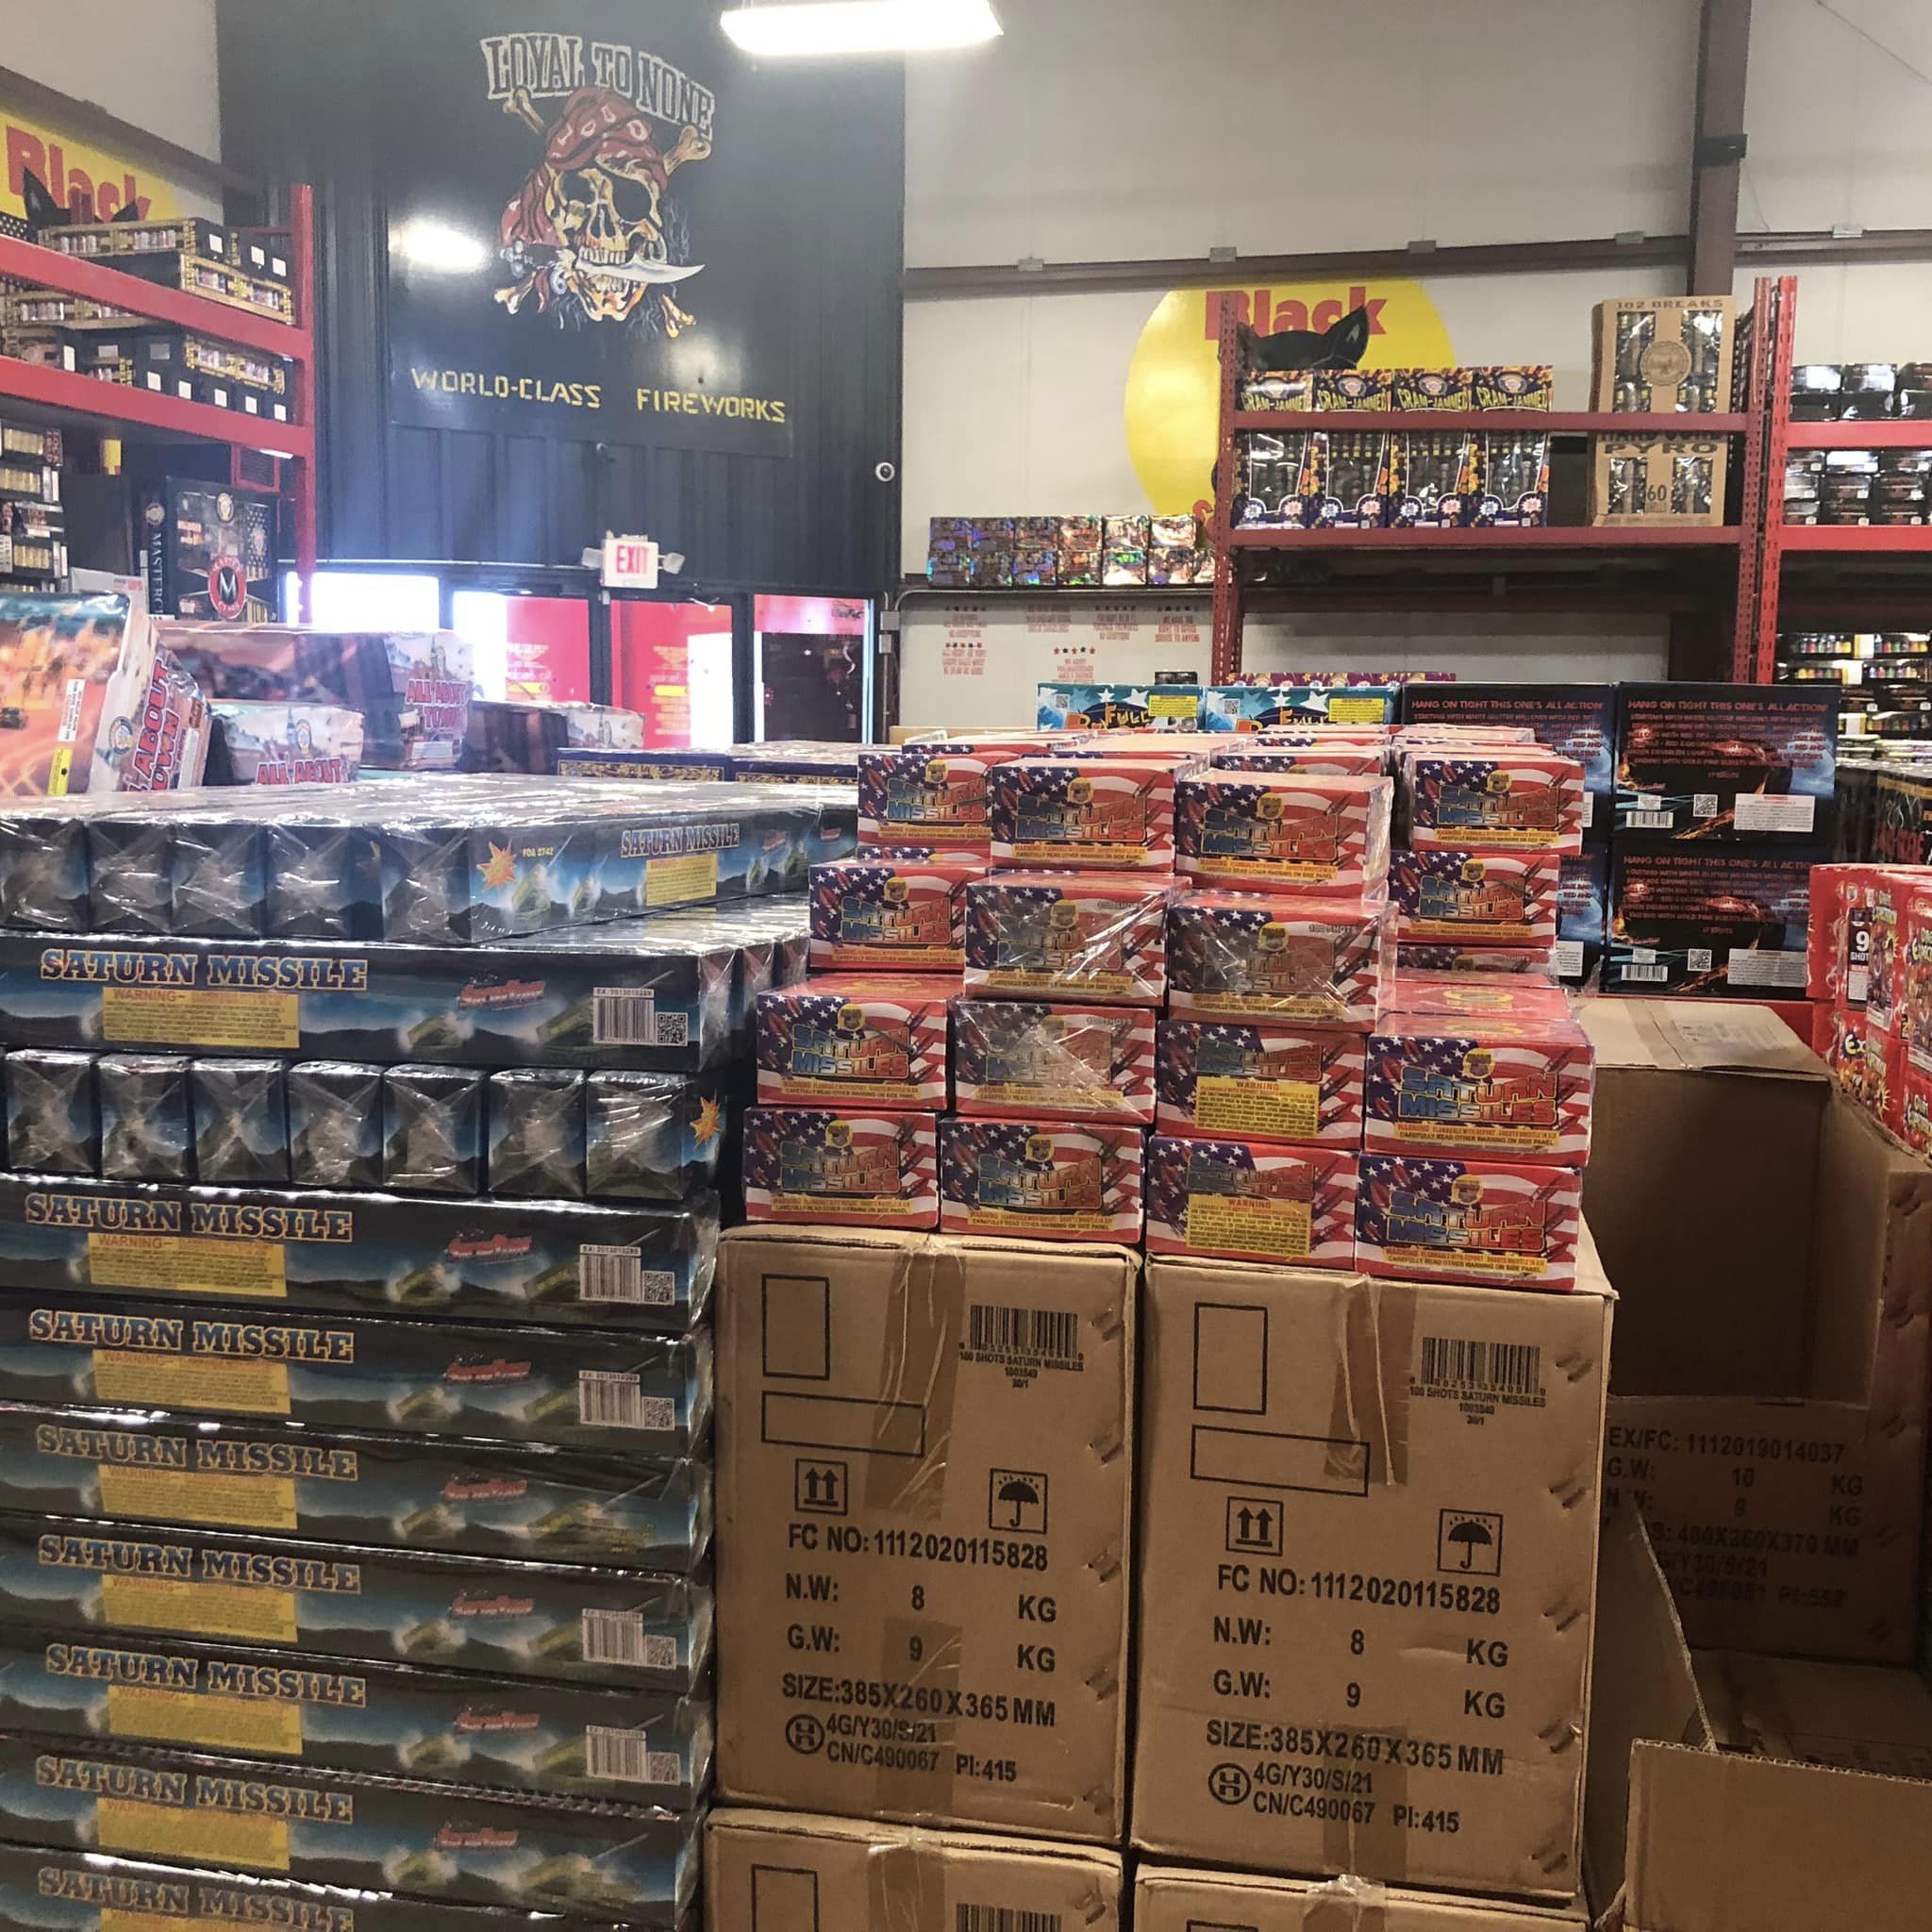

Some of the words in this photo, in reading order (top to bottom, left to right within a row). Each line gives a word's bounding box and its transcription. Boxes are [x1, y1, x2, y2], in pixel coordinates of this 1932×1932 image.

[481, 32, 585, 100] LOYAL
[591, 42, 633, 98] TO
[636, 51, 715, 142] NONE
[1652, 299, 1724, 309] BREAKS
[410, 367, 602, 408] WORLD-CLASS
[636, 388, 787, 424] FIREWORKS
[1604, 442, 1719, 455] PYRO
[1646, 484, 1668, 502] 60
[616, 543, 649, 575] EXIT
[406, 679, 432, 705] ALL
[1411, 700, 1440, 709] HANG
[1441, 700, 1457, 709] ON
[1459, 700, 1489, 709] TIGHT
[1491, 700, 1511, 709] THIS
[1545, 701, 1562, 710] ALL
[1627, 700, 1657, 709] HANG
[1659, 700, 1675, 709] ON
[1678, 701, 1708, 710] TIGHT
[1710, 701, 1732, 711] THIS
[1767, 703, 1786, 712] ALL
[133, 658, 171, 781] ABOUT
[151, 708, 180, 791] OWN
[256, 760, 291, 785] ALL
[620, 828, 681, 858] SATURN
[685, 823, 741, 854] MISSILE
[1856, 930, 1870, 952] 9
[40, 947, 198, 986] SATURN
[206, 953, 370, 991] MISSILE
[791, 1024, 910, 1058] SATURN
[791, 1051, 910, 1080] MISSILES
[1237, 1080, 1279, 1091] WARNING
[1397, 1066, 1558, 1104] SATURN
[1397, 1091, 1558, 1125] MISSILES
[1400, 1131, 1435, 1141] CAREFULLY
[1436, 1133, 1453, 1141] READ
[1454, 1134, 1476, 1142] OTHER
[1477, 1135, 1507, 1144] WARNING
[1507, 1137, 1517, 1145] ON
[1533, 1139, 1555, 1147] PANEL
[978, 1153, 1102, 1190] SATURN
[978, 1179, 1102, 1209] MISSILES
[1228, 1199, 1272, 1208] WARNING
[1386, 1190, 1547, 1227] SATURN
[25, 1192, 182, 1232] SATURN
[190, 1201, 353, 1243] MISSILE
[1386, 1216, 1547, 1253] MISSILES
[29, 1308, 184, 1352] SATURN
[192, 1320, 355, 1364] MISSILE
[959, 1351, 974, 1361] 100
[975, 1352, 1005, 1364] SHOTS
[1007, 1356, 1041, 1368] SATURN
[1043, 1358, 1084, 1372] MISSILES
[1409, 1385, 1424, 1397] 100
[1426, 1387, 1459, 1400] SHOTS
[1461, 1391, 1499, 1404] SATURN
[1502, 1393, 1546, 1408] MISSILES
[36, 1424, 187, 1468] SATURN
[196, 1440, 358, 1481] MISSILE
[1608, 1425, 1679, 1452] EX/FC:
[1687, 1432, 1845, 1463] 1112019014037
[1606, 1457, 1656, 1480] G.W:
[1731, 1467, 1755, 1488] 10
[1830, 1474, 1863, 1497] KG
[1828, 1505, 1862, 1527] KG
[38, 1533, 192, 1578] SATURN
[202, 1548, 361, 1594] MISSILE
[788, 1523, 818, 1551] FC
[827, 1526, 869, 1554] NO:
[874, 1530, 1048, 1572] 1112020115828
[785, 1573, 839, 1603] N.W:
[911, 1584, 925, 1611] 8
[1018, 1593, 1058, 1624] KG
[1218, 1564, 1250, 1592] FC
[1259, 1567, 1306, 1596] NO:
[1311, 1571, 1500, 1616] 1112020115828
[787, 1623, 841, 1653] G.W:
[908, 1635, 923, 1662] 9
[1017, 1644, 1056, 1673] KG
[1214, 1616, 1272, 1647] N.W:
[1350, 1628, 1365, 1656] 8
[1466, 1638, 1509, 1668] KG
[45, 1643, 198, 1690] SATURN
[208, 1661, 367, 1708] MISSILE
[1213, 1669, 1272, 1699] G.W:
[1346, 1682, 1361, 1708] 9
[1464, 1689, 1506, 1719] KG
[1013, 1698, 1056, 1727] MM
[827, 1740, 940, 1772] CN/C490067
[956, 1753, 1018, 1783] PI:415
[1253, 1761, 1374, 1794] 4G/Y30/S/21
[1457, 1743, 1504, 1775] MM
[35, 1756, 189, 1804] SATURN
[194, 1774, 354, 1824] MISSILE
[1253, 1790, 1375, 1824] CN/C490067
[1392, 1802, 1460, 1834] PI:415
[38, 1866, 190, 1913] SATURN
[198, 1889, 355, 1932] MISSILE
